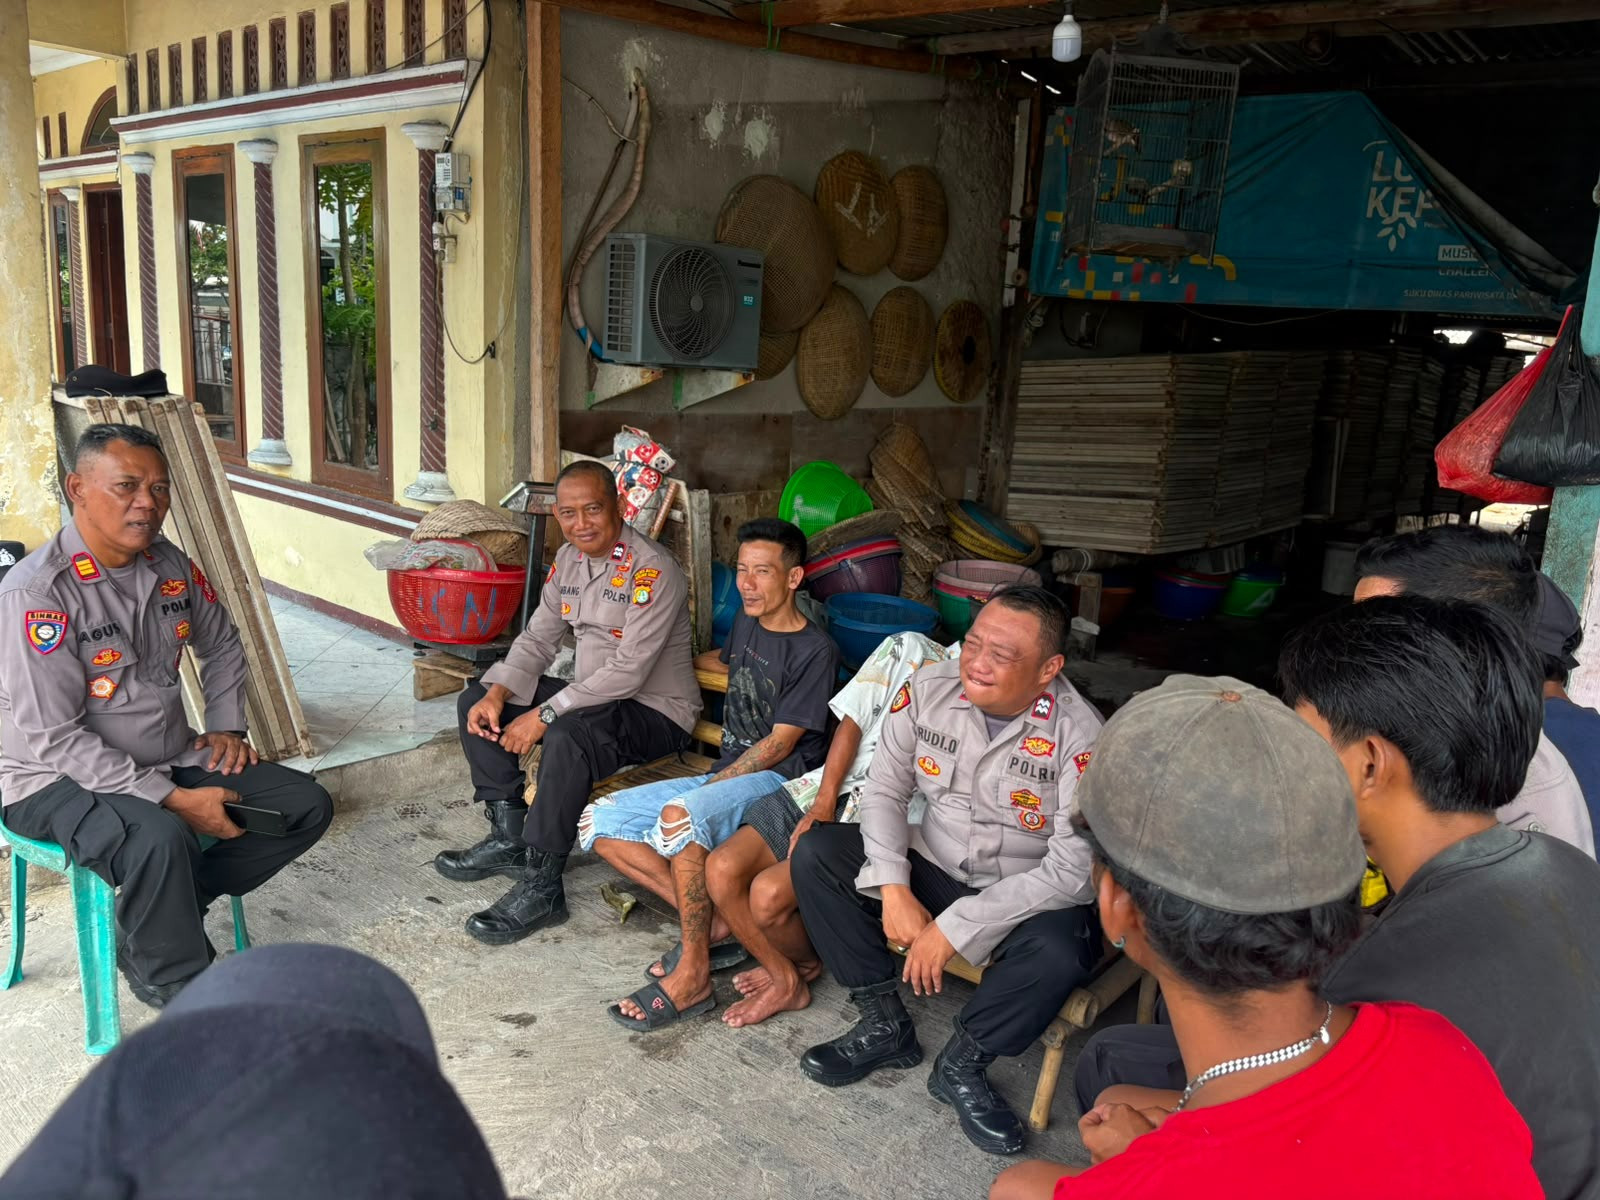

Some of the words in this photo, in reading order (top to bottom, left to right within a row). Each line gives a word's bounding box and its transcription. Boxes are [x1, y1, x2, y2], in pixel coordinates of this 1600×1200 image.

[603, 589, 631, 604] POLRI
[79, 622, 121, 644] AGUS
[1009, 757, 1056, 781] POLRI
